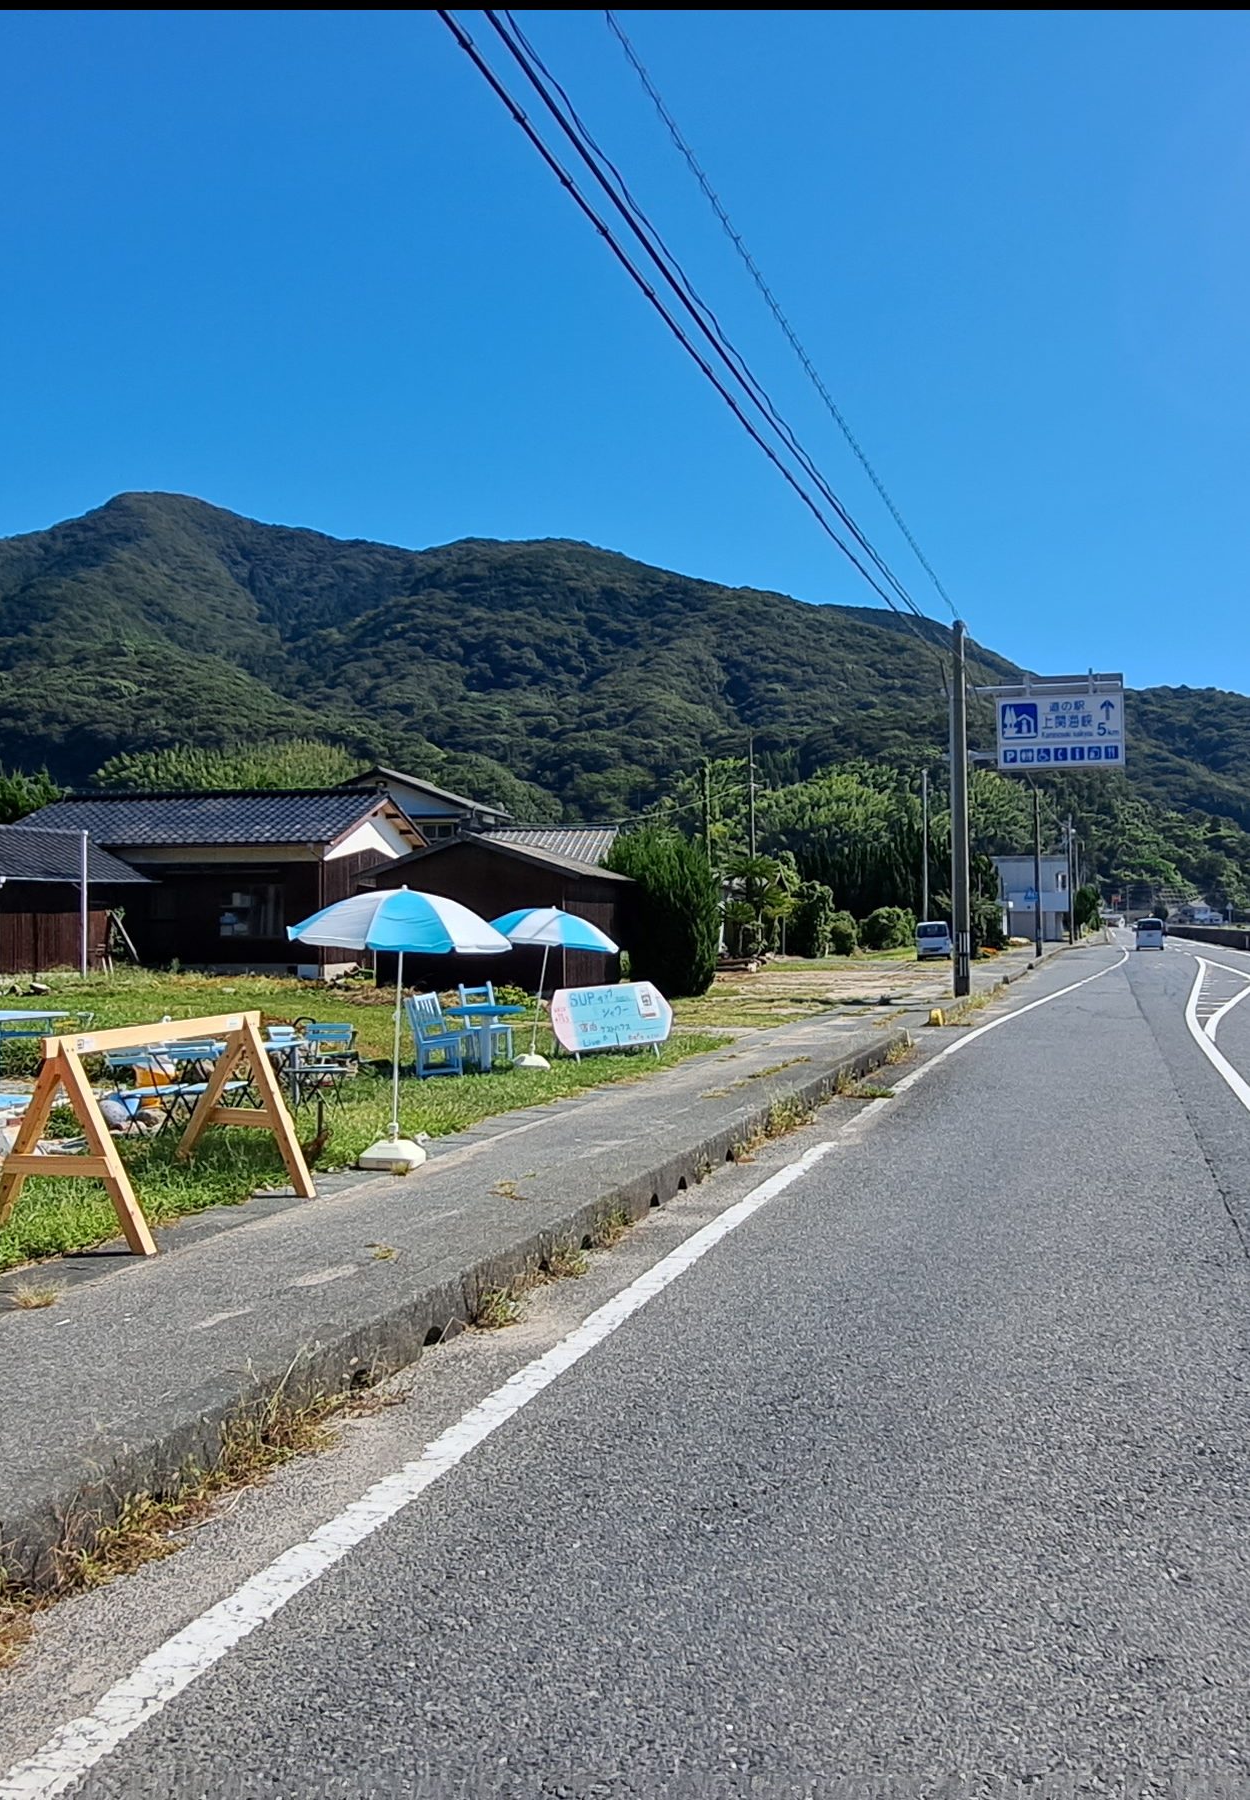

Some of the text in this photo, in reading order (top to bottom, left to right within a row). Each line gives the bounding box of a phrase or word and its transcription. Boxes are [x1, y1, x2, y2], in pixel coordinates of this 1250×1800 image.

[1049, 700, 1086, 712] 道の駅
[569, 992, 595, 1007] SUP
